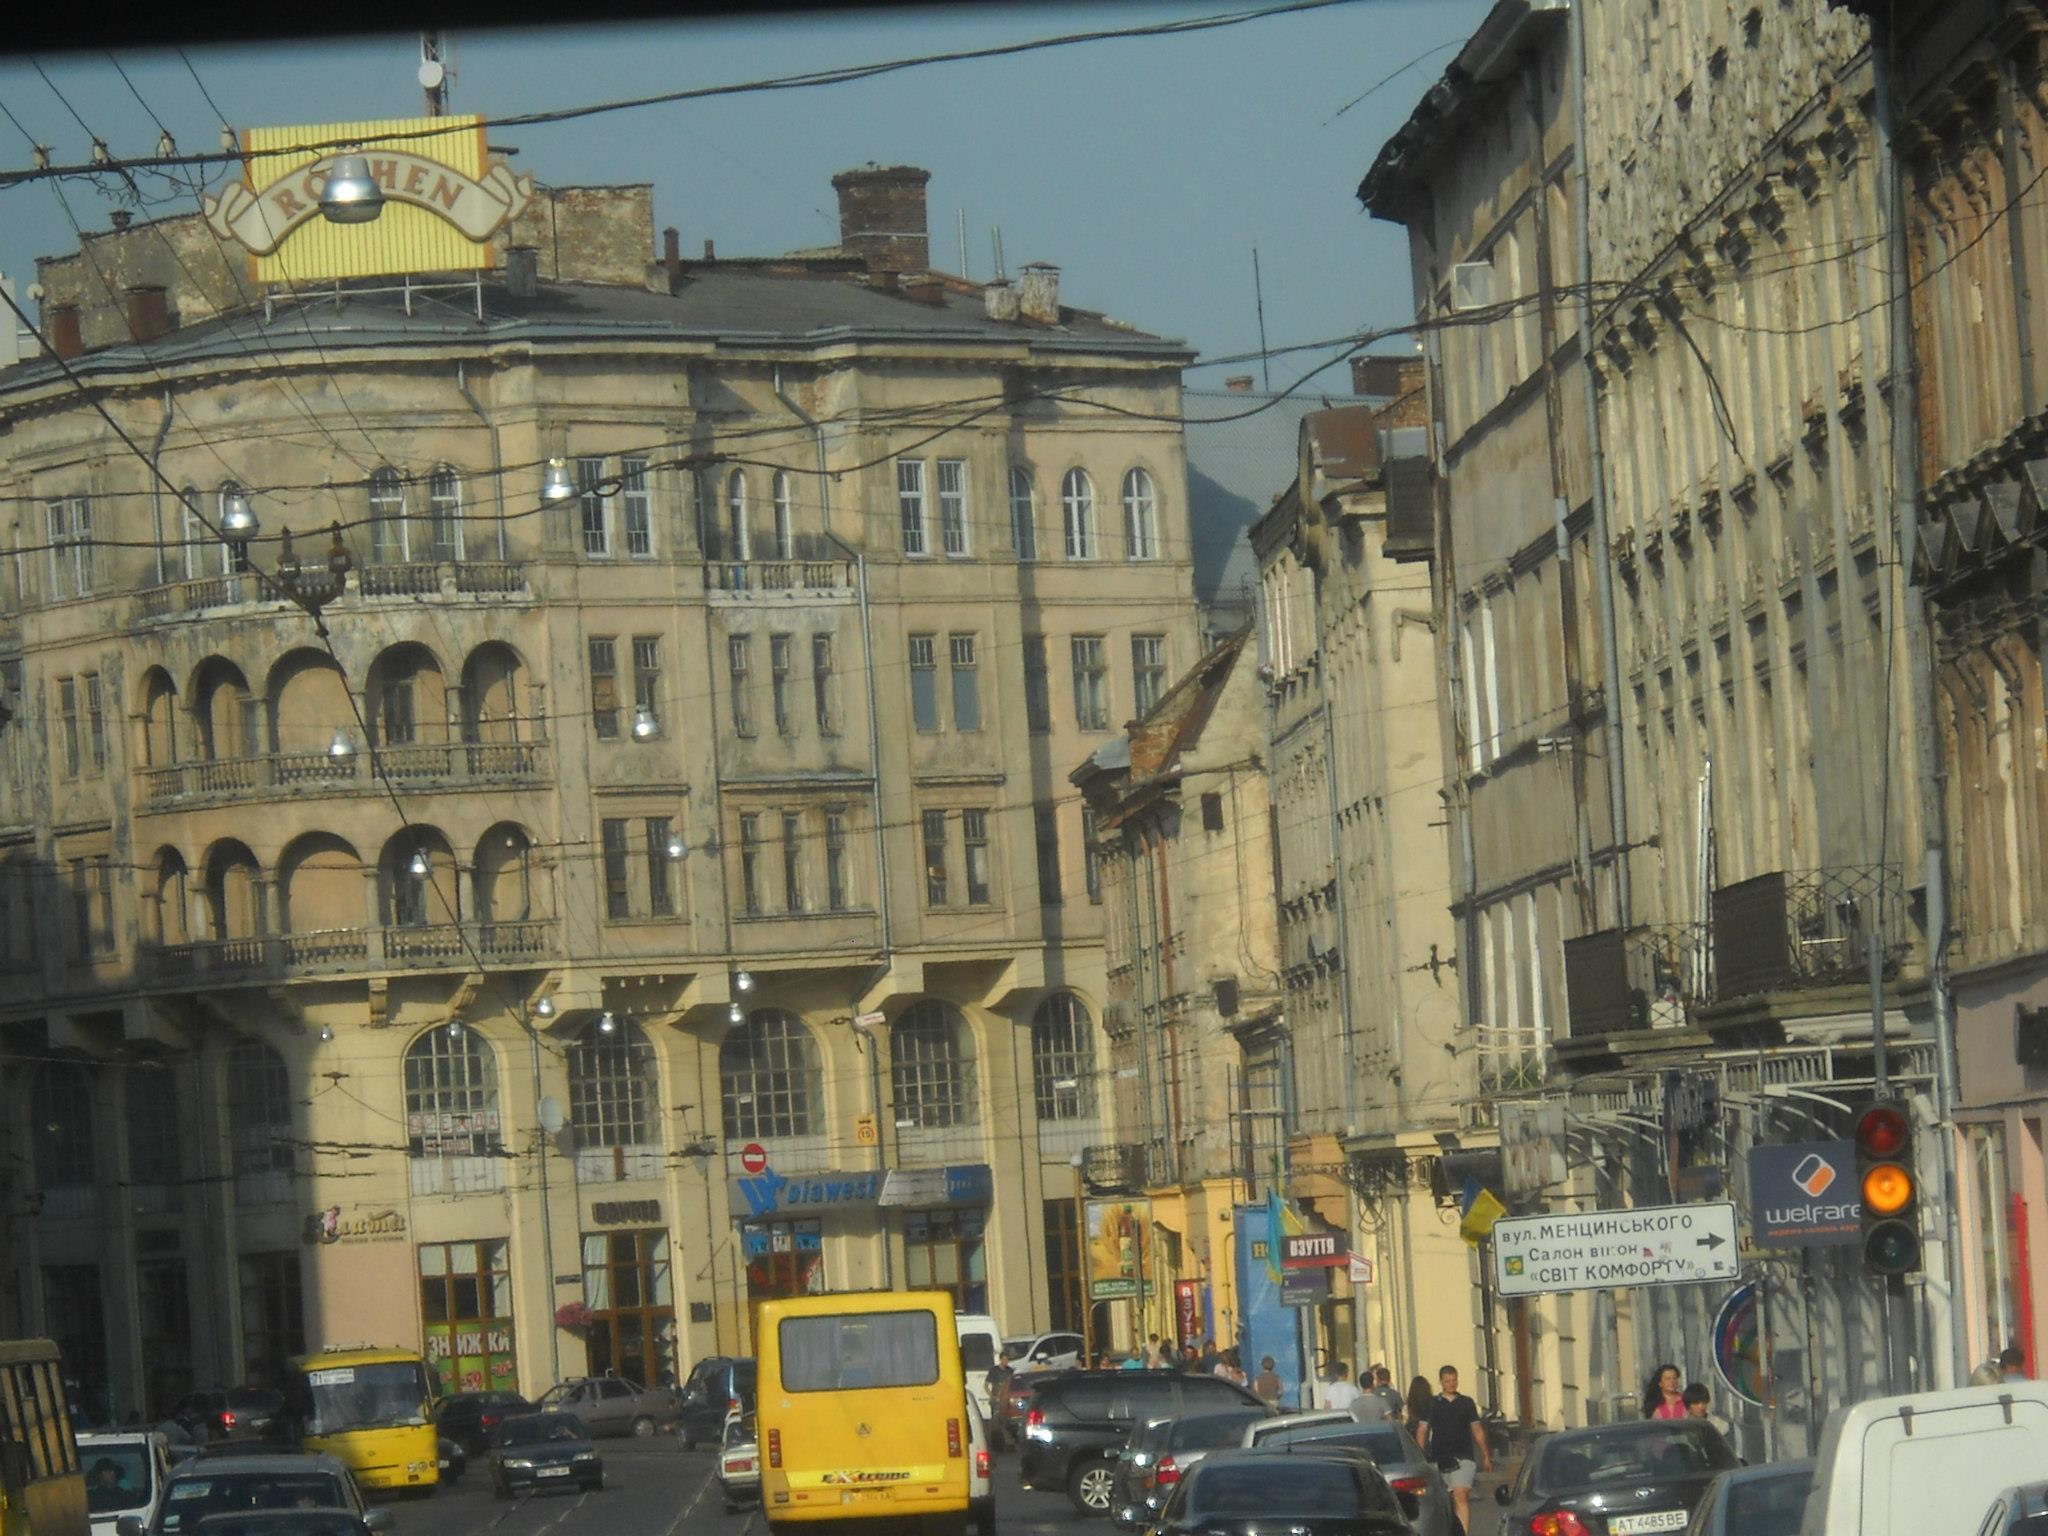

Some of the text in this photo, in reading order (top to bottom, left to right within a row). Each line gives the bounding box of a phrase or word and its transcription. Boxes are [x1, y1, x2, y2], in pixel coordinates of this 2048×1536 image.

[272, 159, 464, 220] ROHEN
[1765, 1203, 1861, 1224] welfare
[1502, 1214, 1693, 1245] вул. МЕНЦИНСЬКОГО
[1289, 1237, 1336, 1257] ВЗУТТЯ
[1528, 1247, 1584, 1262] Салон
[427, 1331, 510, 1364] ЗНИЖКИ
